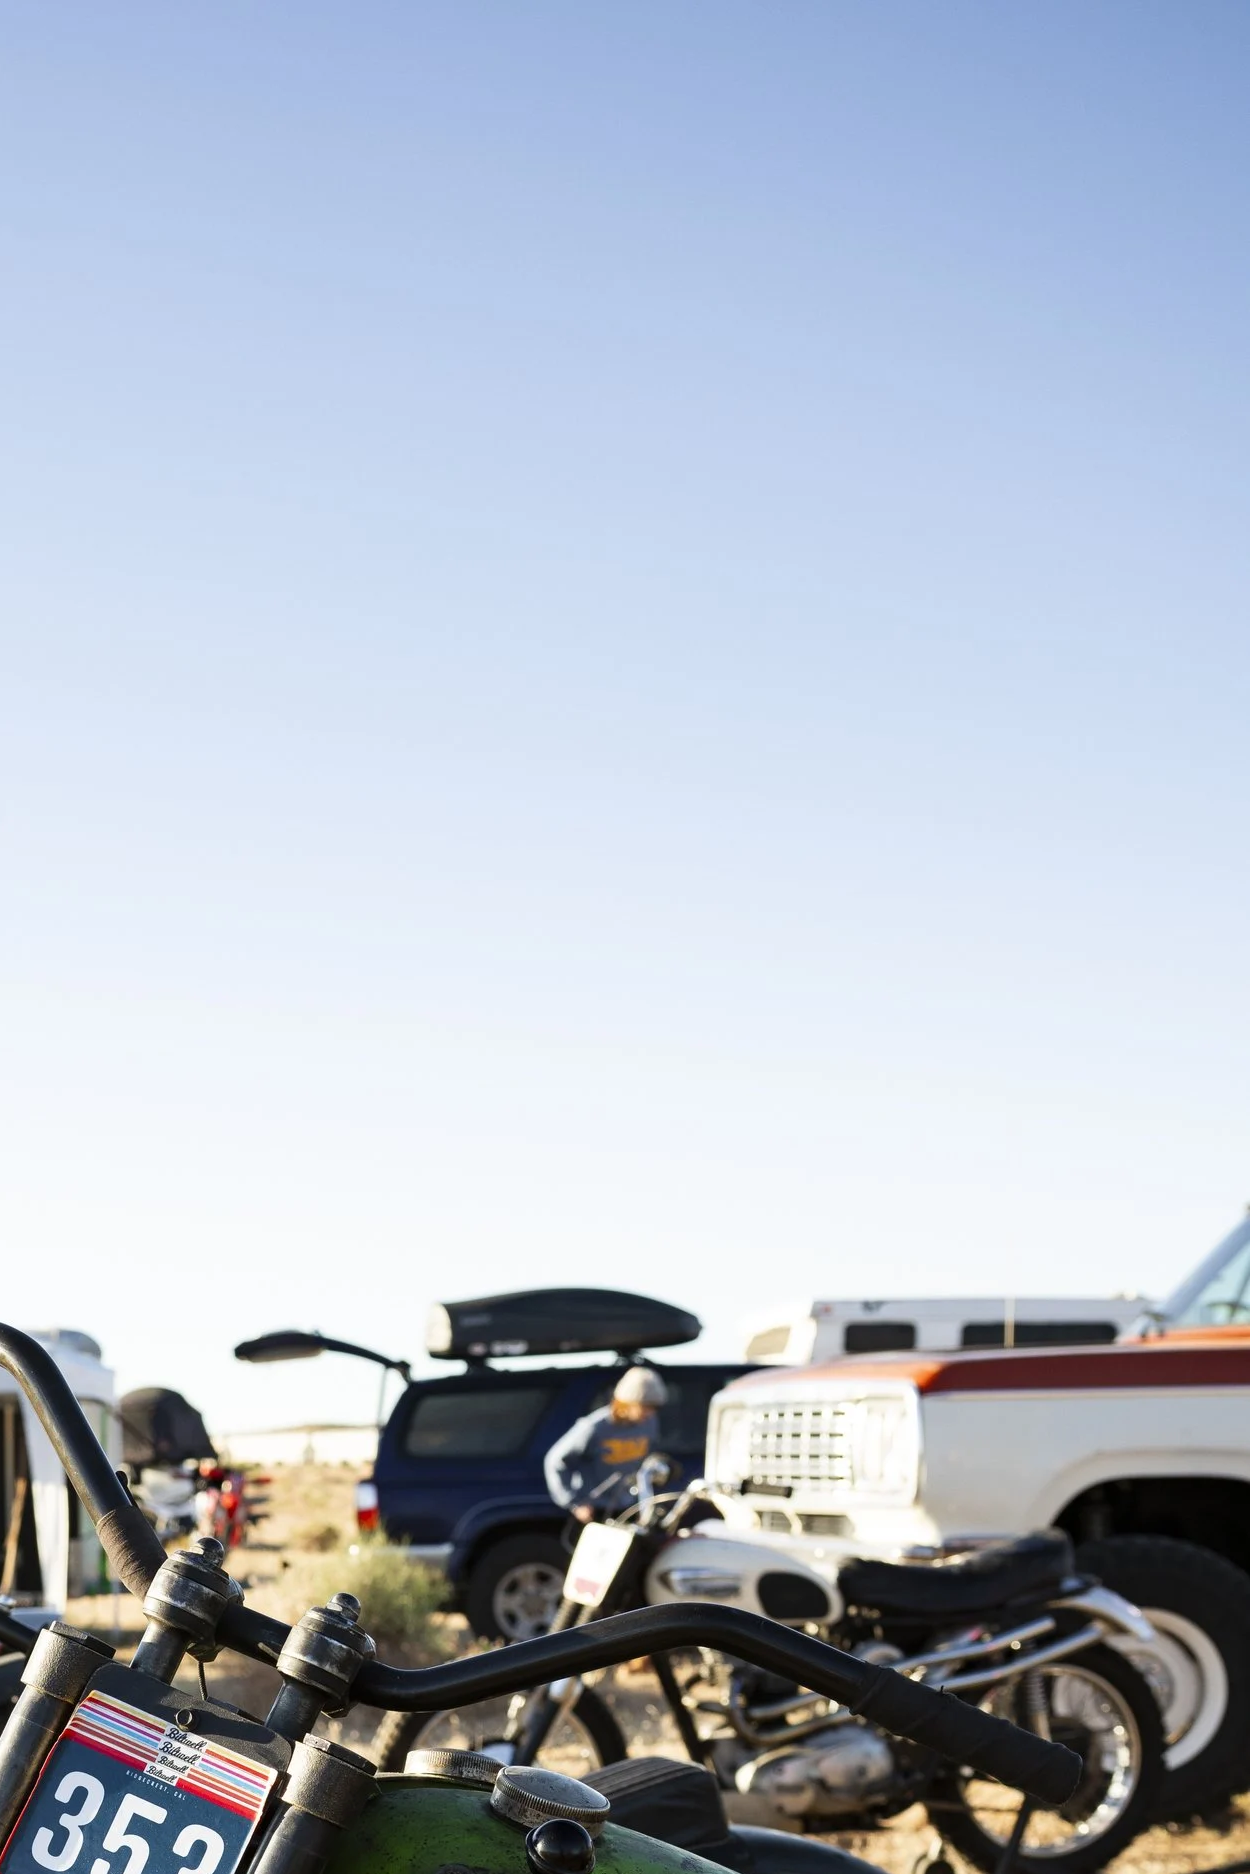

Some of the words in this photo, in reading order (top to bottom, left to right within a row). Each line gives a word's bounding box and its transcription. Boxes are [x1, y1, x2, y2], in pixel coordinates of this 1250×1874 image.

[166, 1727, 207, 1751] Biltwell
[159, 1741, 201, 1765] Biltwell
[146, 1765, 178, 1784] Biltwell
[157, 1755, 190, 1774] Biltwell
